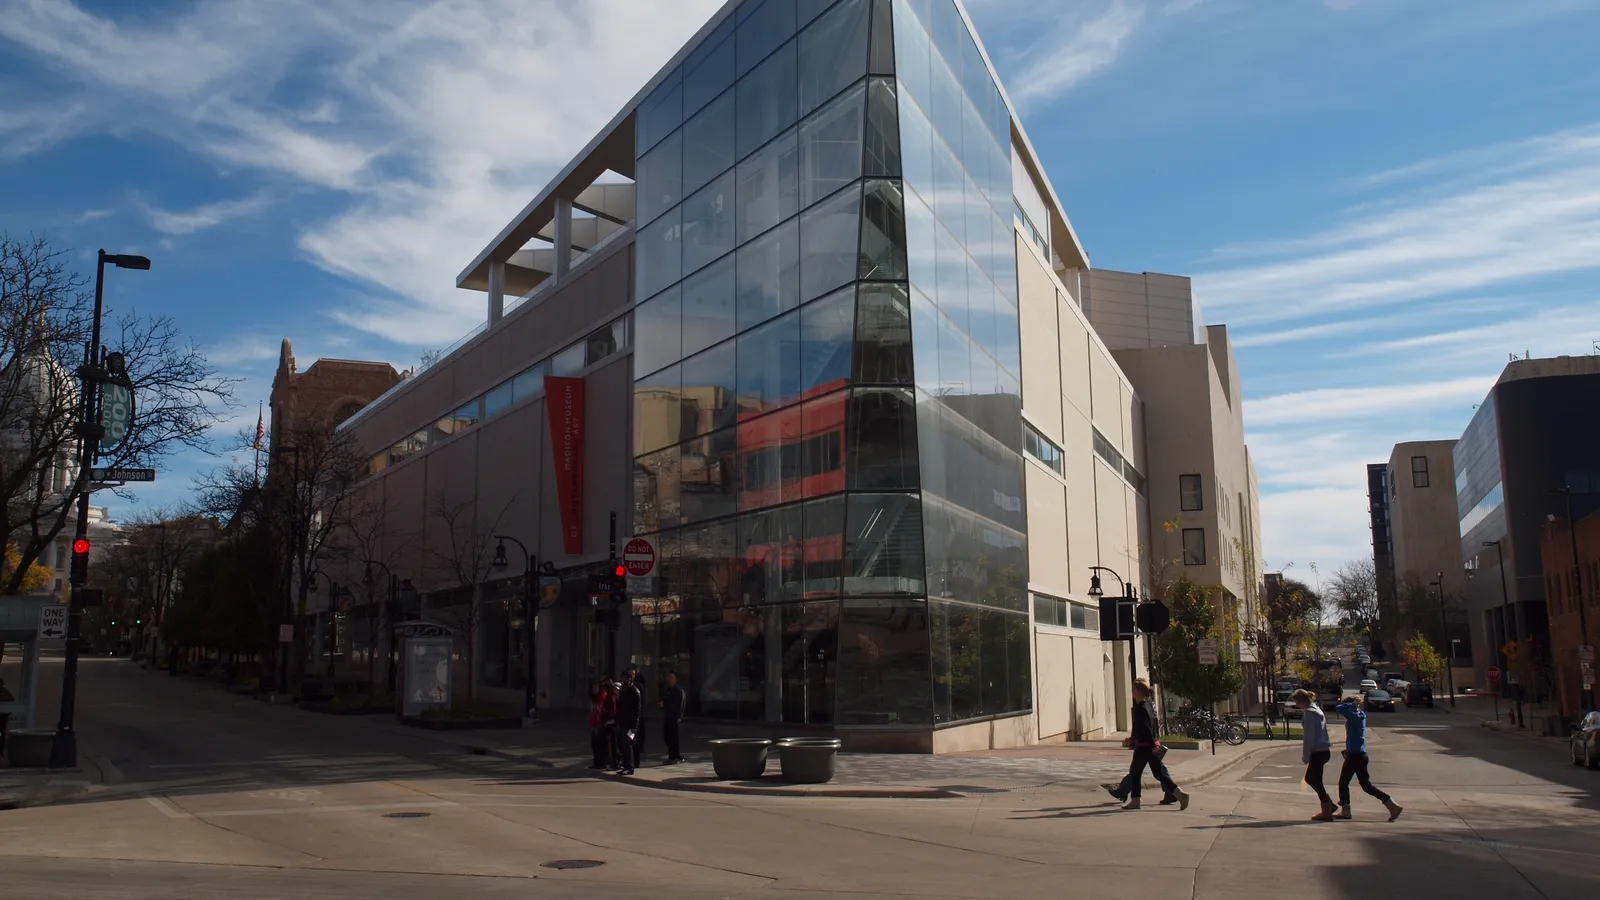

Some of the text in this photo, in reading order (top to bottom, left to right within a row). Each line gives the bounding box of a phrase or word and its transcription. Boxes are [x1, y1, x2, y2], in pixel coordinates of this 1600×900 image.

[103, 393, 112, 437] BLOCK
[111, 385, 128, 439] 200
[564, 385, 572, 471] MADISON MUSEUM
[111, 470, 146, 480] Johnson
[43, 618, 64, 626] WAY
[44, 608, 64, 617] ONE
